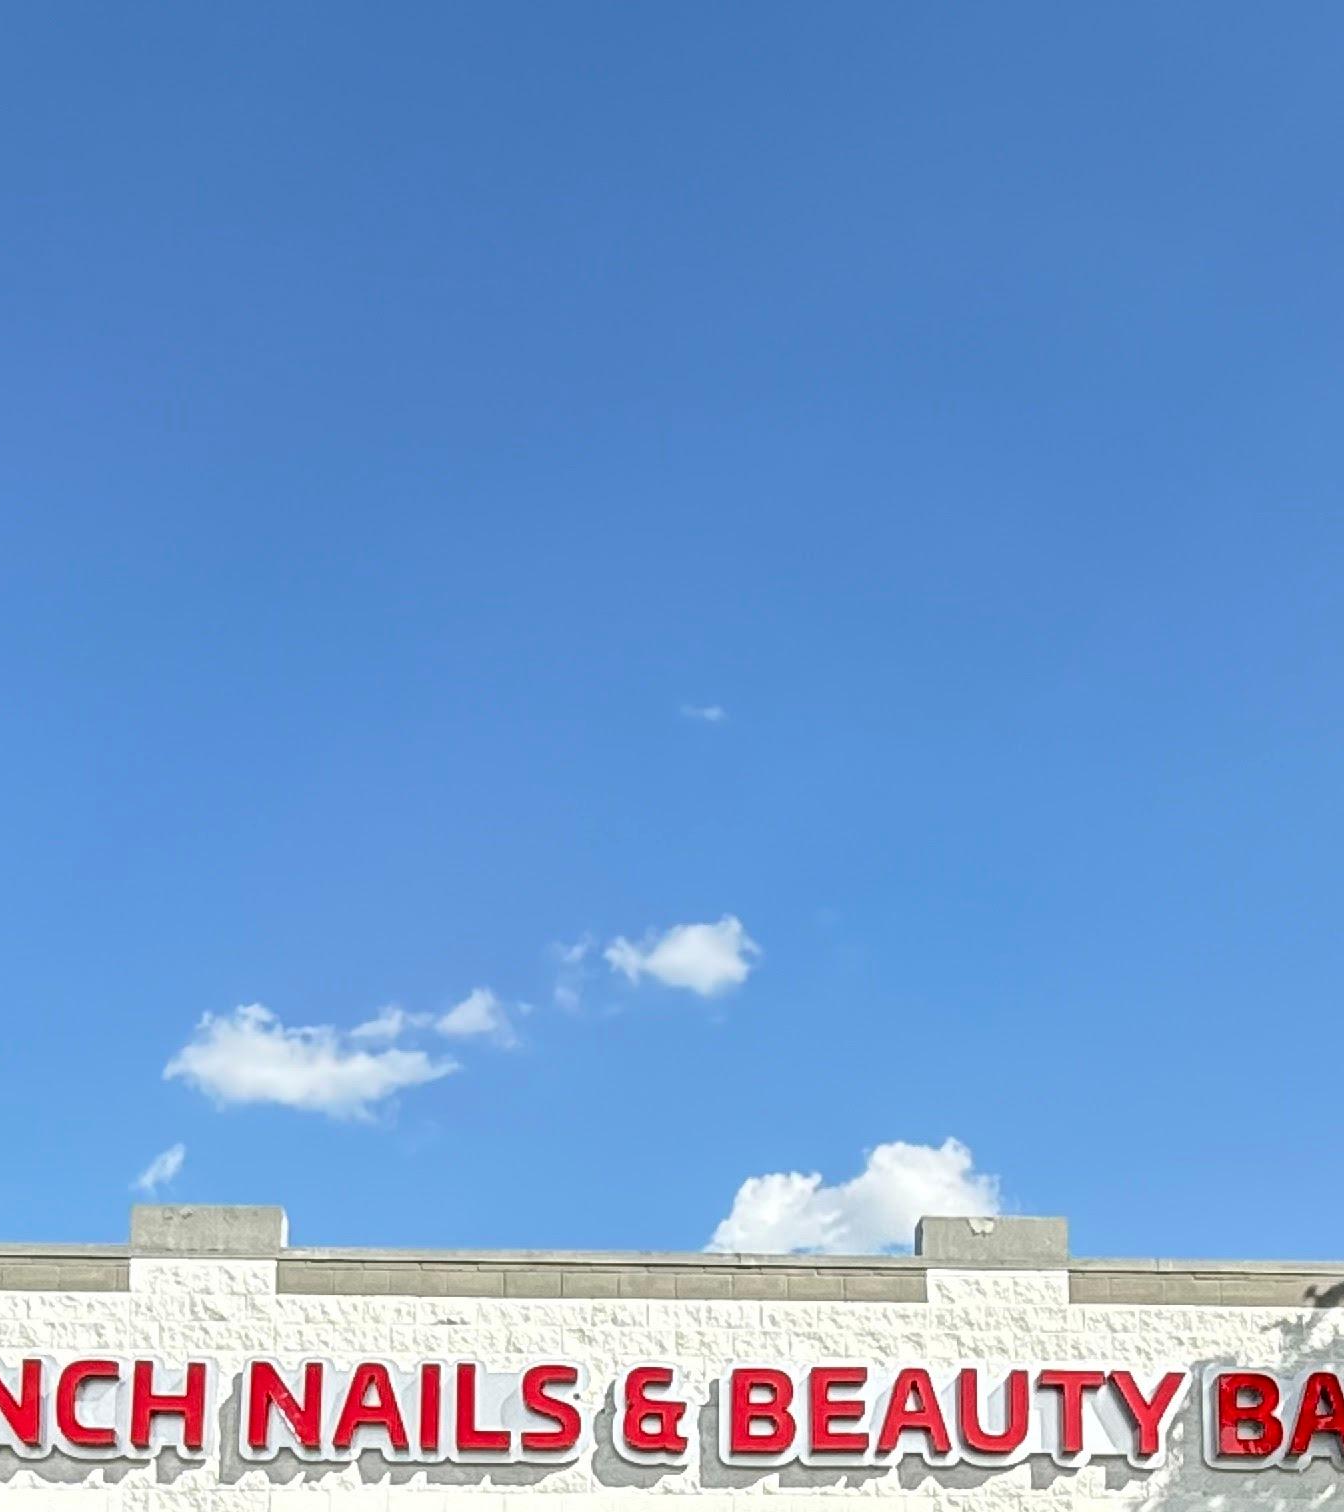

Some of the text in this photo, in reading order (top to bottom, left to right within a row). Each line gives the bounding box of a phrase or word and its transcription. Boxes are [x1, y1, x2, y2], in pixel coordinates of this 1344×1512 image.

[247, 1362, 582, 1452] NAILS
[622, 1366, 687, 1453] &
[730, 1367, 1183, 1455] BEAUTY
